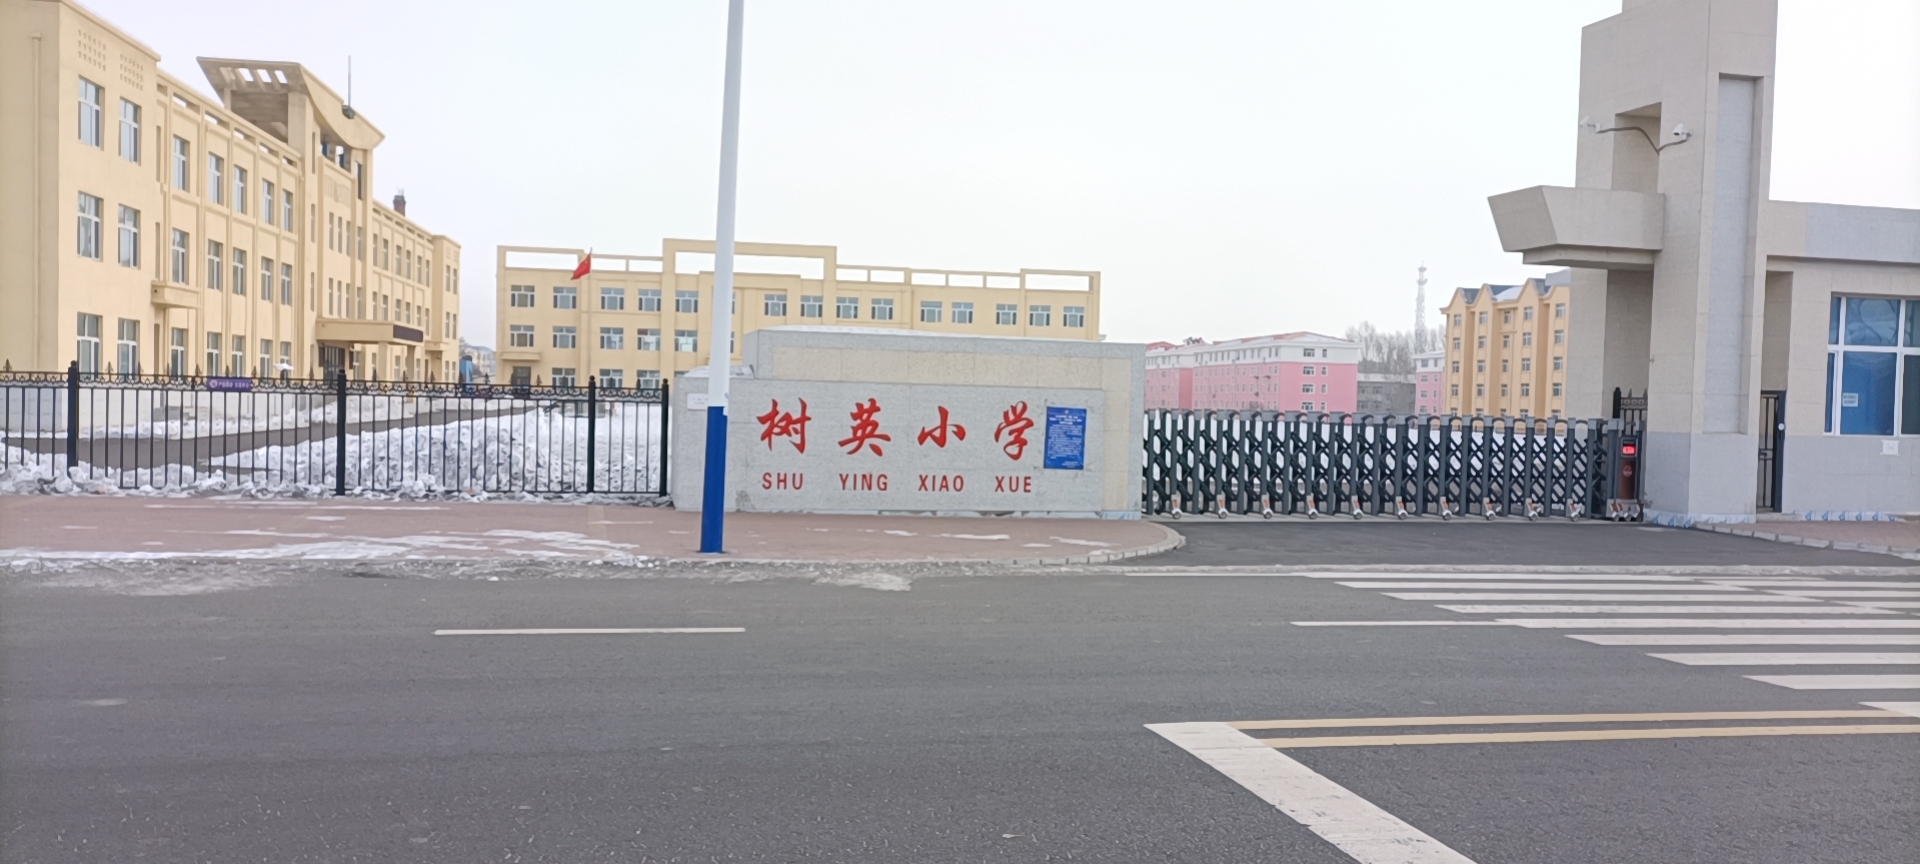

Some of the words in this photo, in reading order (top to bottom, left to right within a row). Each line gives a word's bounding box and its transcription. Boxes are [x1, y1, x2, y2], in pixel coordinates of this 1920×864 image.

[757, 397, 1035, 461] 树英小学
[762, 472, 804, 490] SHU
[839, 473, 888, 491] YING
[918, 475, 965, 492] XIAO
[995, 475, 1032, 493] XUE
